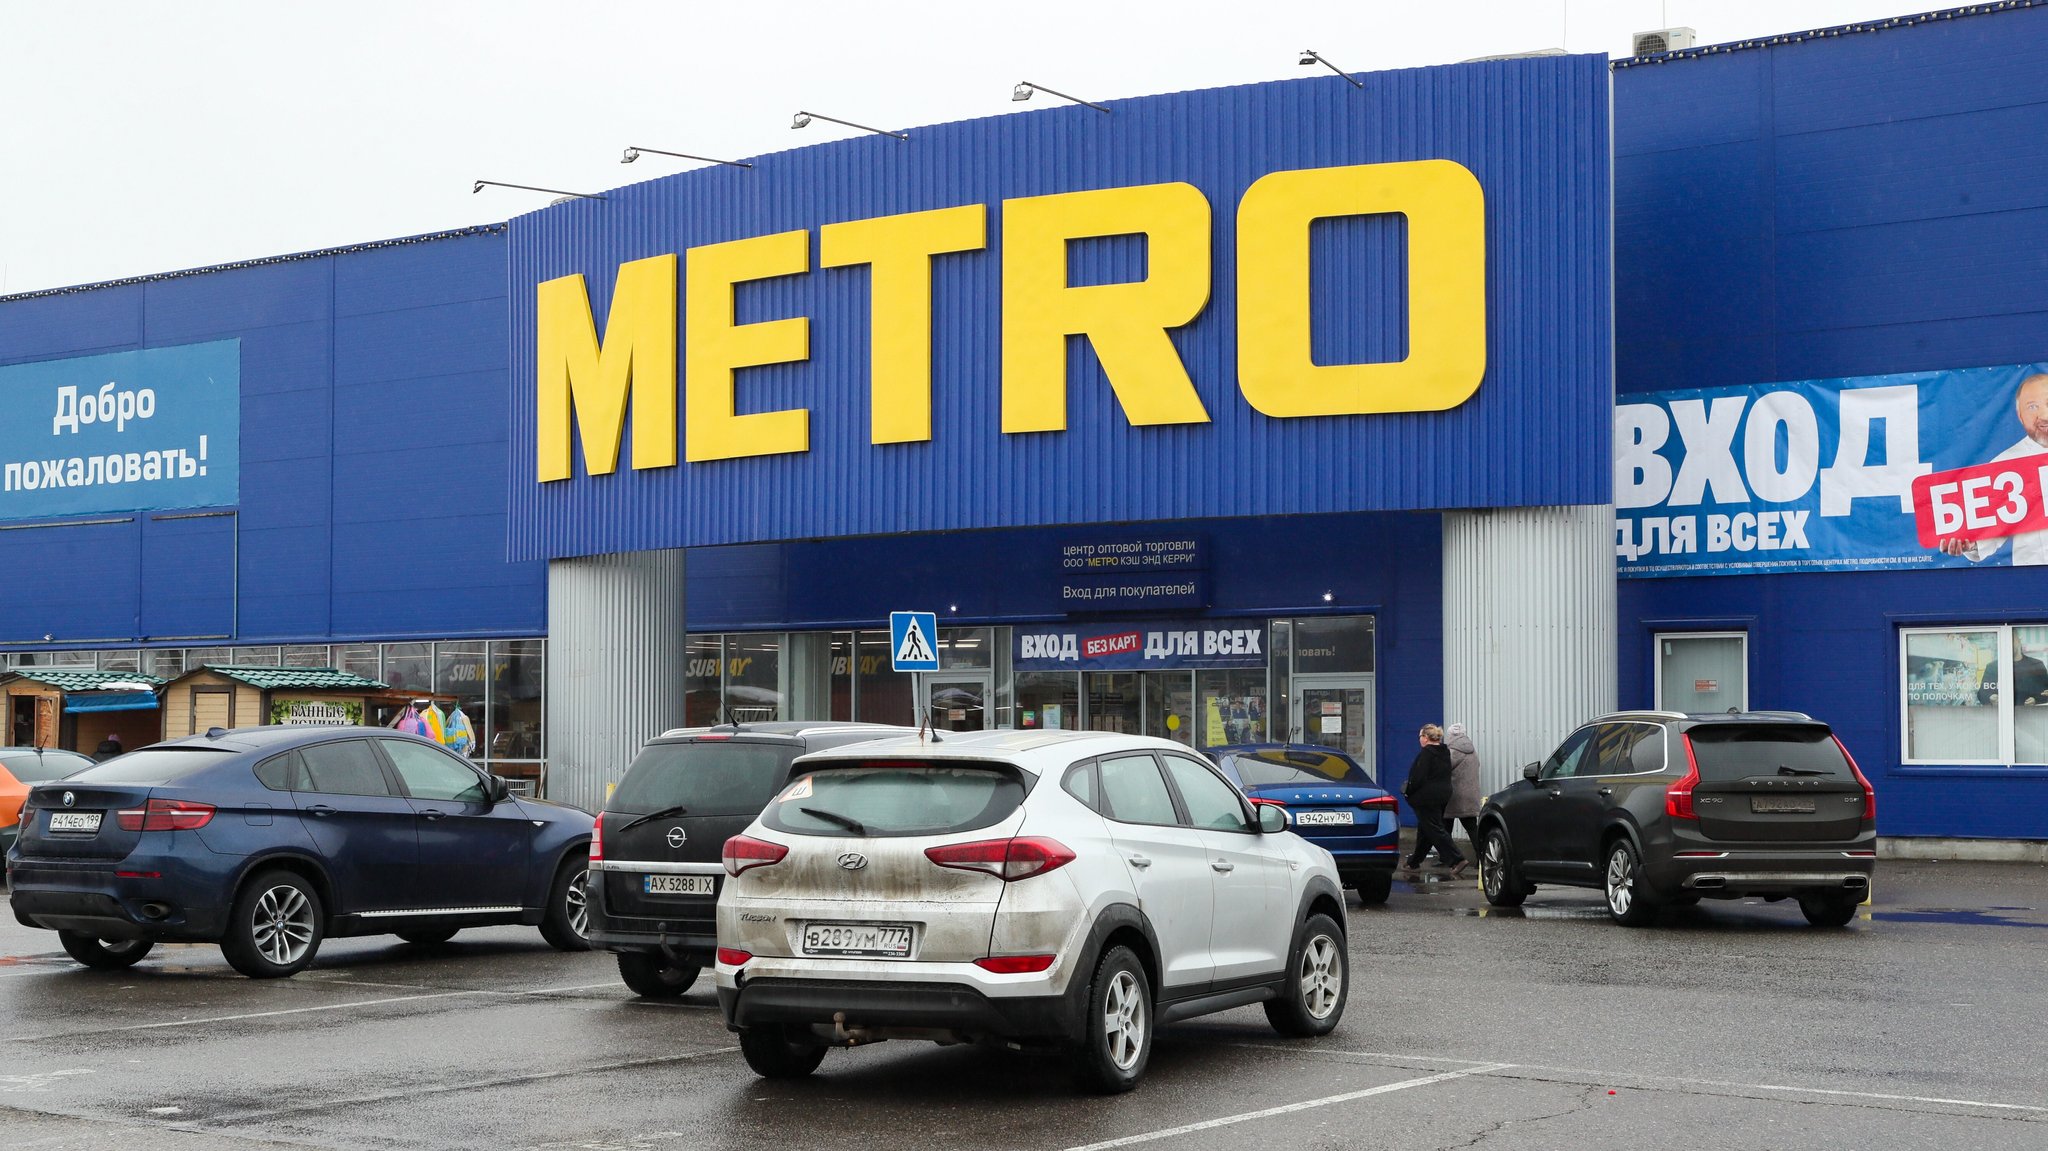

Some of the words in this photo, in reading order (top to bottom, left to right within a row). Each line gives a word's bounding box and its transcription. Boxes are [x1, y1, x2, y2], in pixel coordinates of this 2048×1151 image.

[537, 158, 1486, 484] METRO
[53, 381, 156, 436] Добро
[1616, 384, 1933, 517] ВХОД
[4, 434, 208, 492] пожаловать!
[1929, 470, 2029, 537] БЕЗ
[1707, 510, 1811, 553] ВСЕХ
[1063, 544, 1095, 557] центр
[1097, 540, 1143, 554] оптовой
[1145, 540, 1196, 554] торговли
[1063, 558, 1084, 568] ООО
[1120, 555, 1140, 566] КЭШ
[1142, 555, 1161, 566] ЭНД
[1063, 585, 1092, 600] Вход
[1094, 587, 1117, 599] для
[1120, 581, 1195, 599] покупателей
[1021, 633, 1079, 661] ВХОД
[1087, 638, 1108, 654] БЕЗ
[1108, 634, 1137, 652] КАРТ
[1144, 630, 1198, 660] ДЛЯ
[1203, 629, 1262, 655] ВСЕХ
[449, 663, 508, 681] SUBWY
[291, 705, 345, 718] БАННЫЕ
[86, 813, 100, 825] 199
[1336, 812, 1351, 821] 790
[650, 877, 666, 891] AX
[669, 877, 695, 892] 5288
[879, 928, 906, 943] 777
